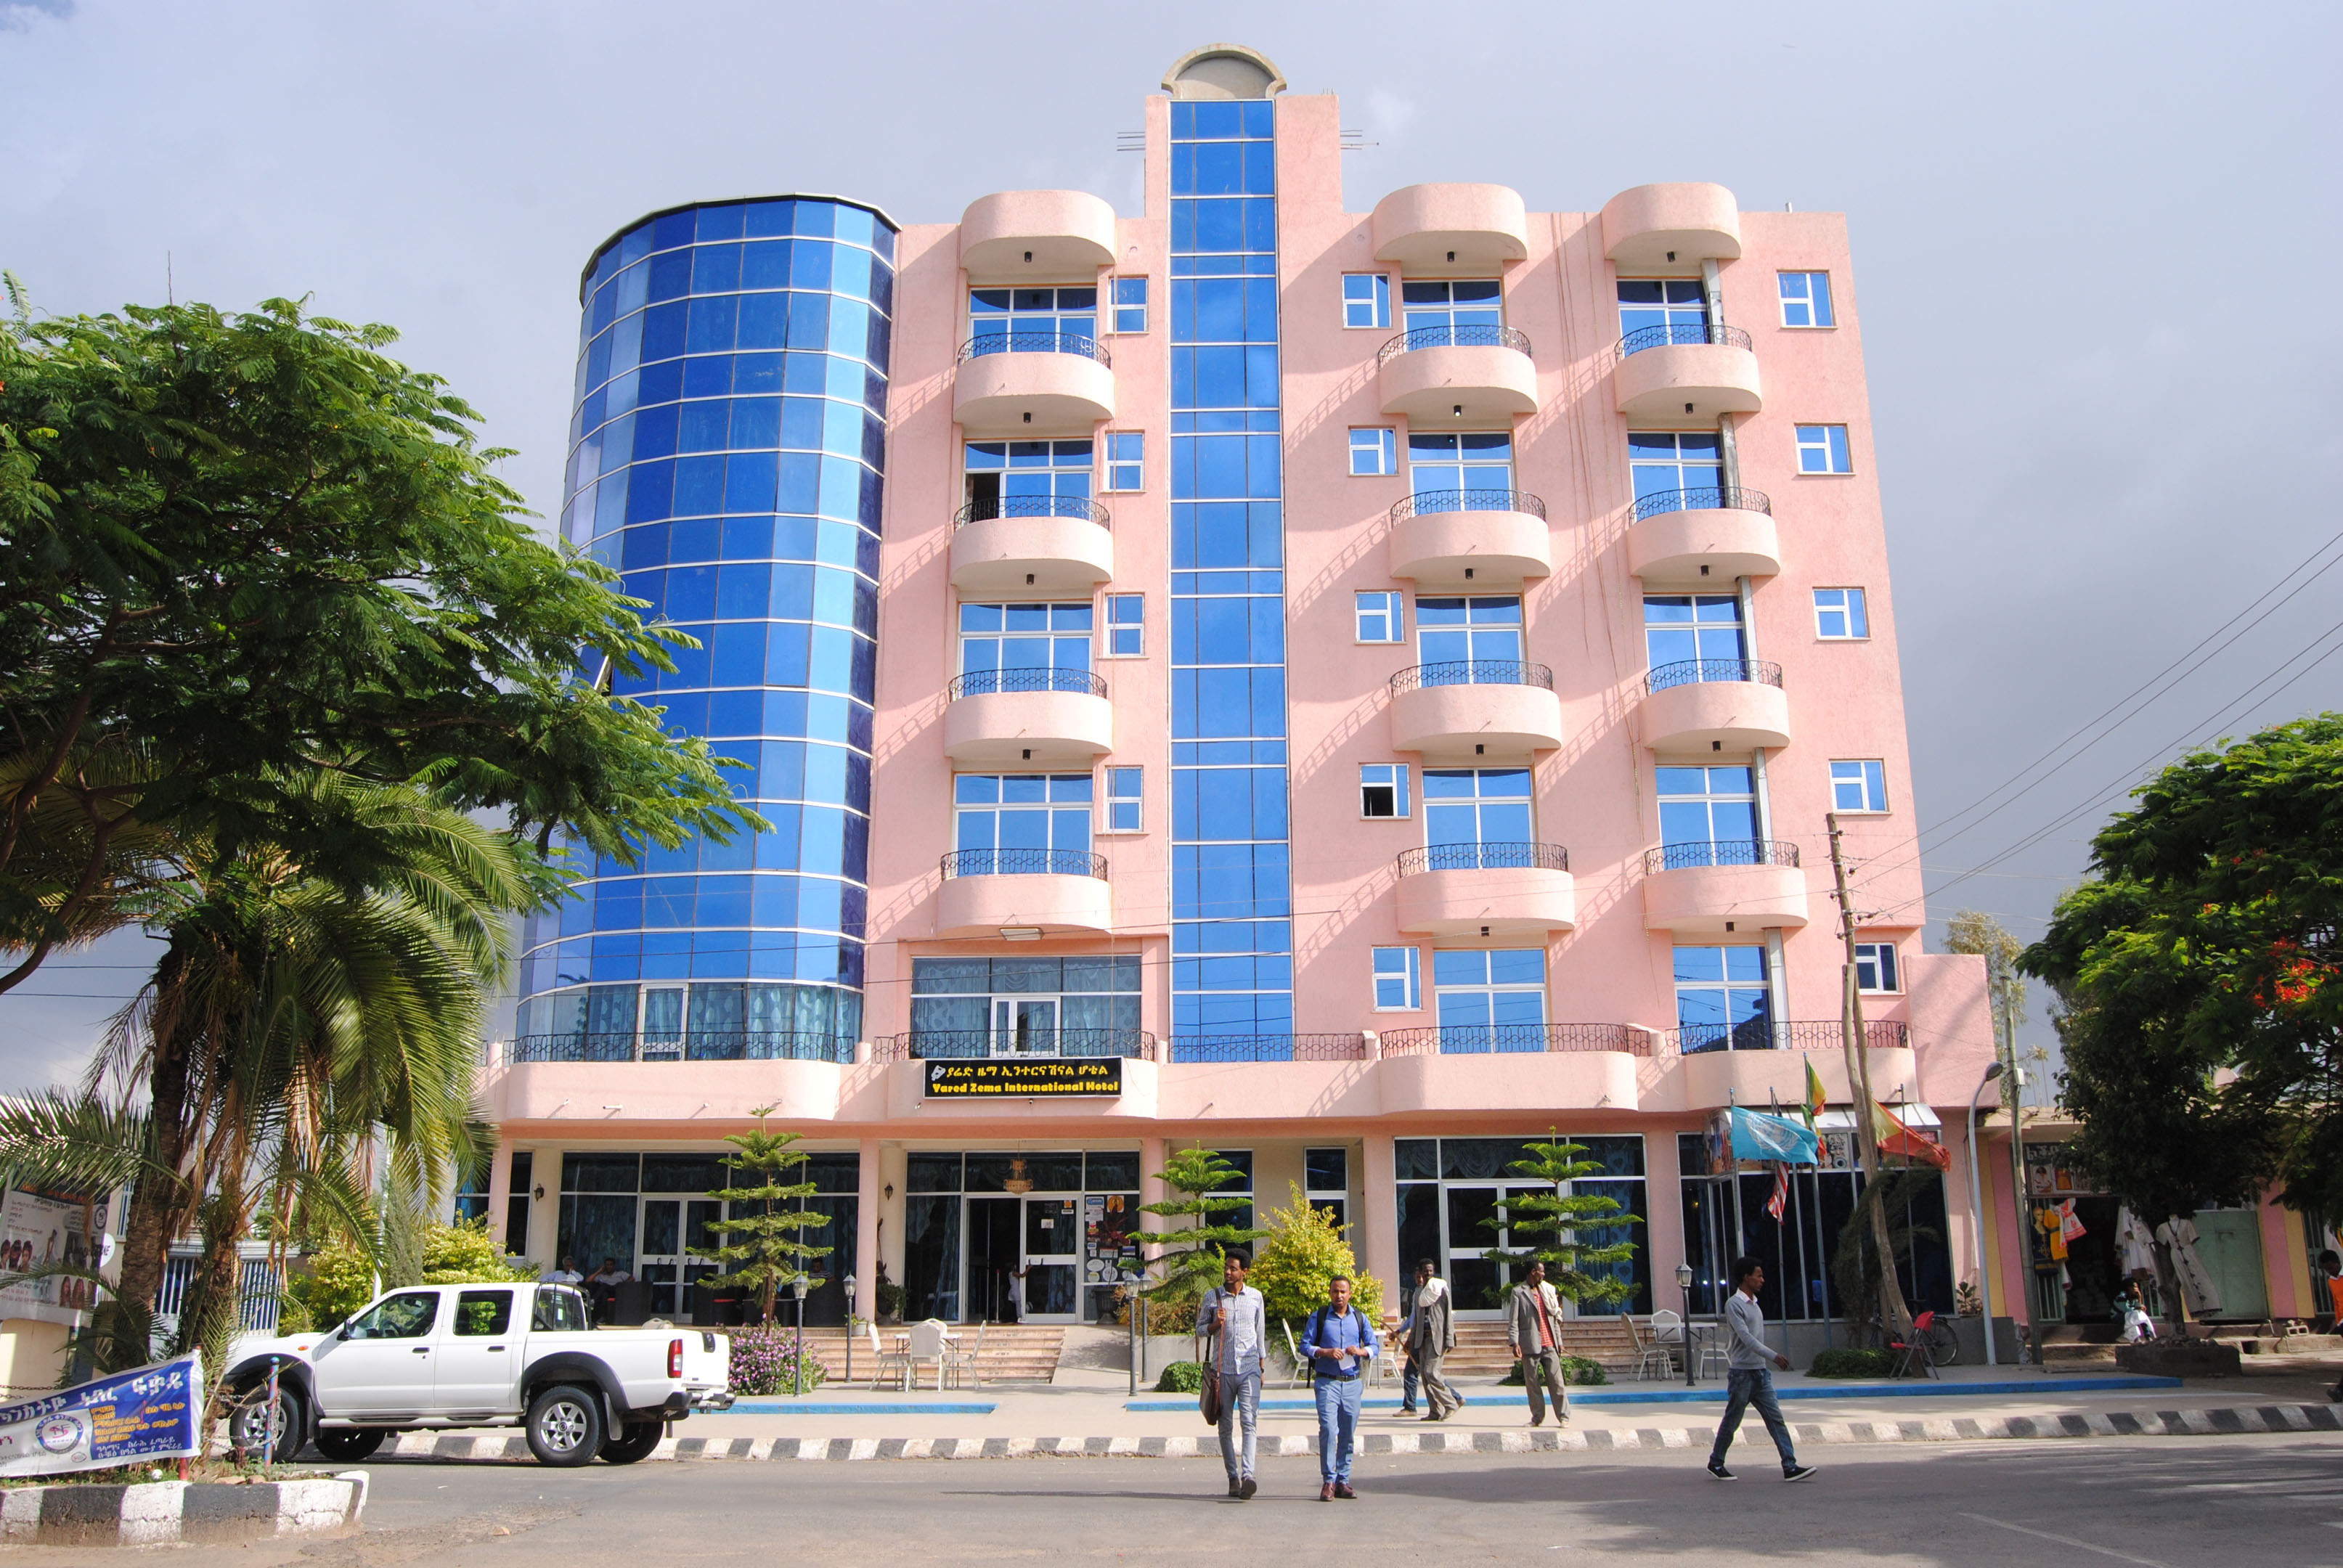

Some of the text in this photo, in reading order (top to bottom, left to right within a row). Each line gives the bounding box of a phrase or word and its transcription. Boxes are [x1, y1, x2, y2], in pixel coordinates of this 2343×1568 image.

[977, 1066, 998, 1077] ዜማ
[1078, 1064, 1108, 1075] ሆቴል
[933, 1082, 1118, 1093] Yared Zema International Hotel
